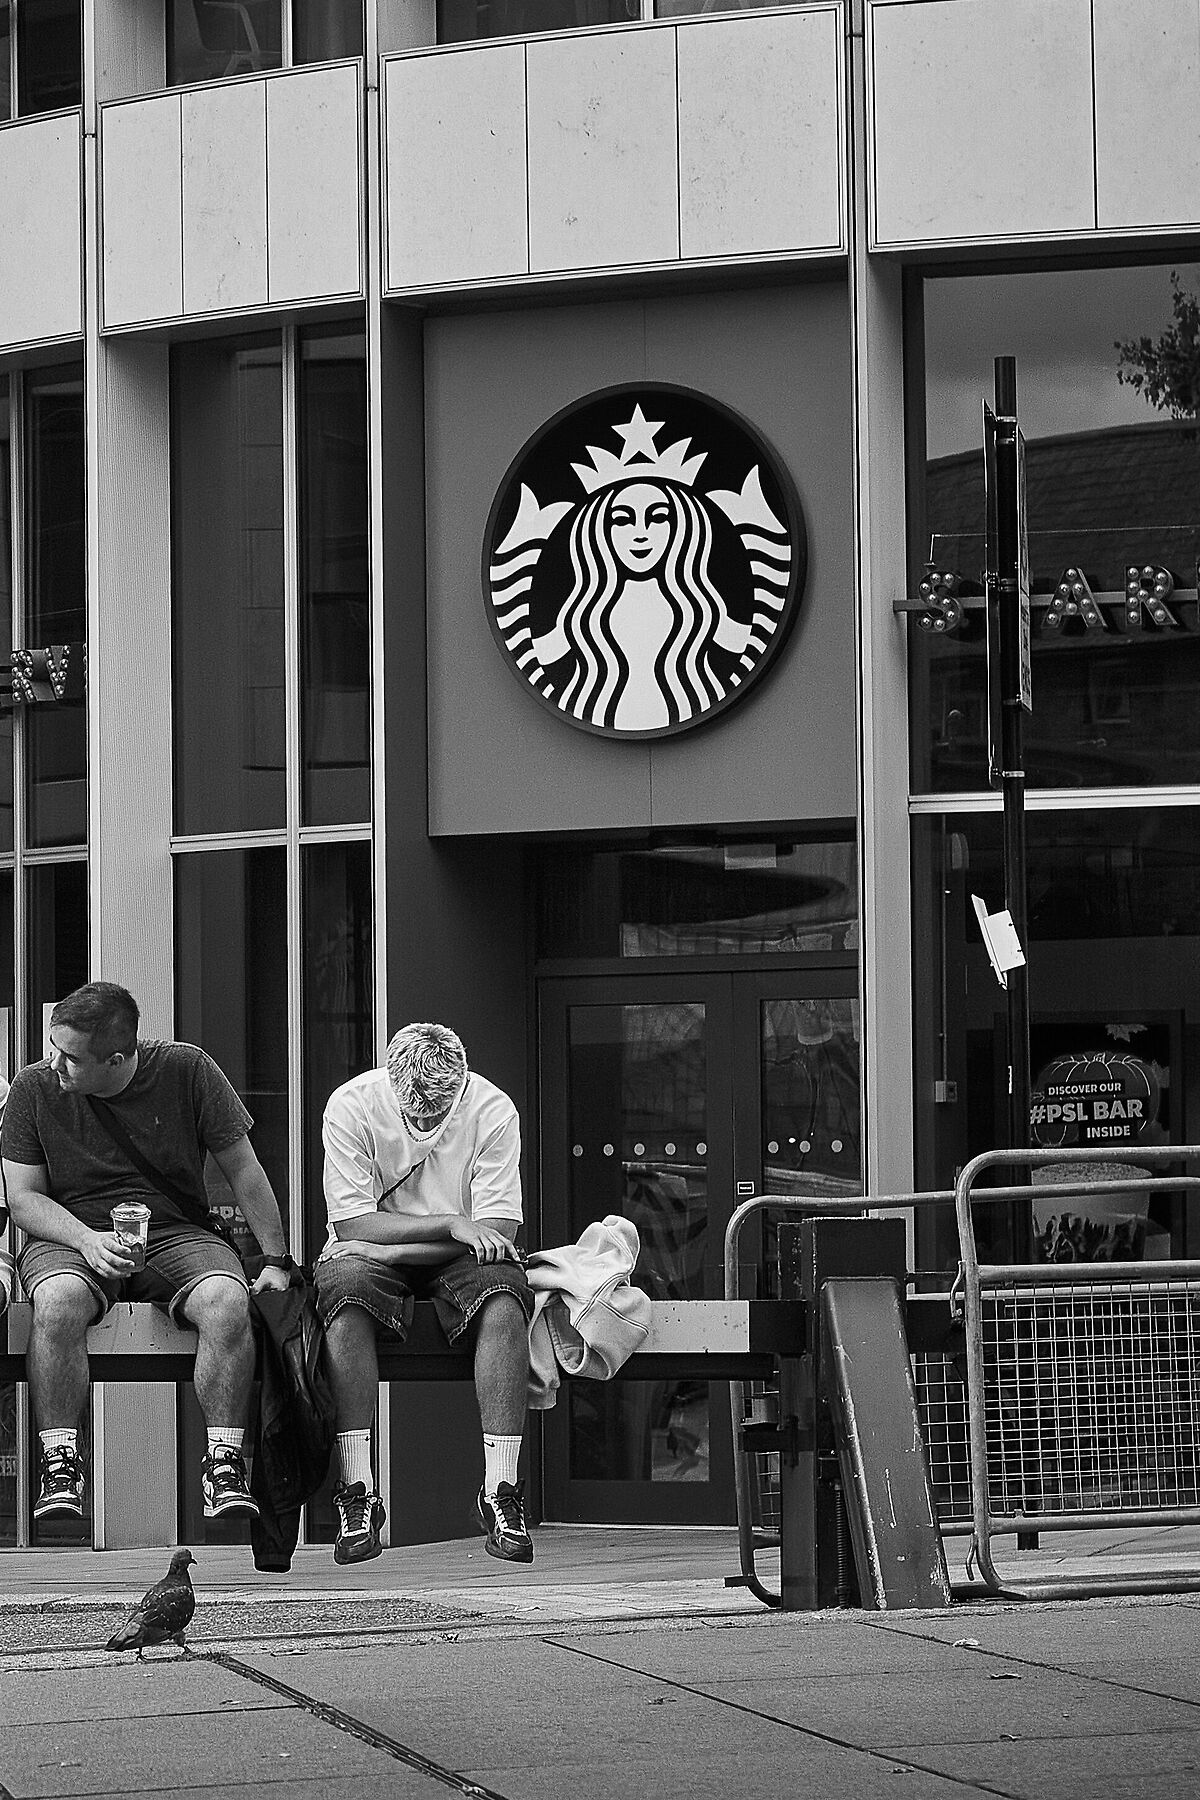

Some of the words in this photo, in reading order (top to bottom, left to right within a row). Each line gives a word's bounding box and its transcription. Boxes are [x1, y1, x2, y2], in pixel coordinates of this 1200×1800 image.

[916, 566, 1200, 633] SAR
[1048, 1084, 1097, 1096] DISCOVER
[1099, 1082, 1122, 1093] OUR
[1030, 1102, 1088, 1124] #PSL
[1093, 1099, 1143, 1121] BAR
[1086, 1125, 1131, 1138] INSIDE
